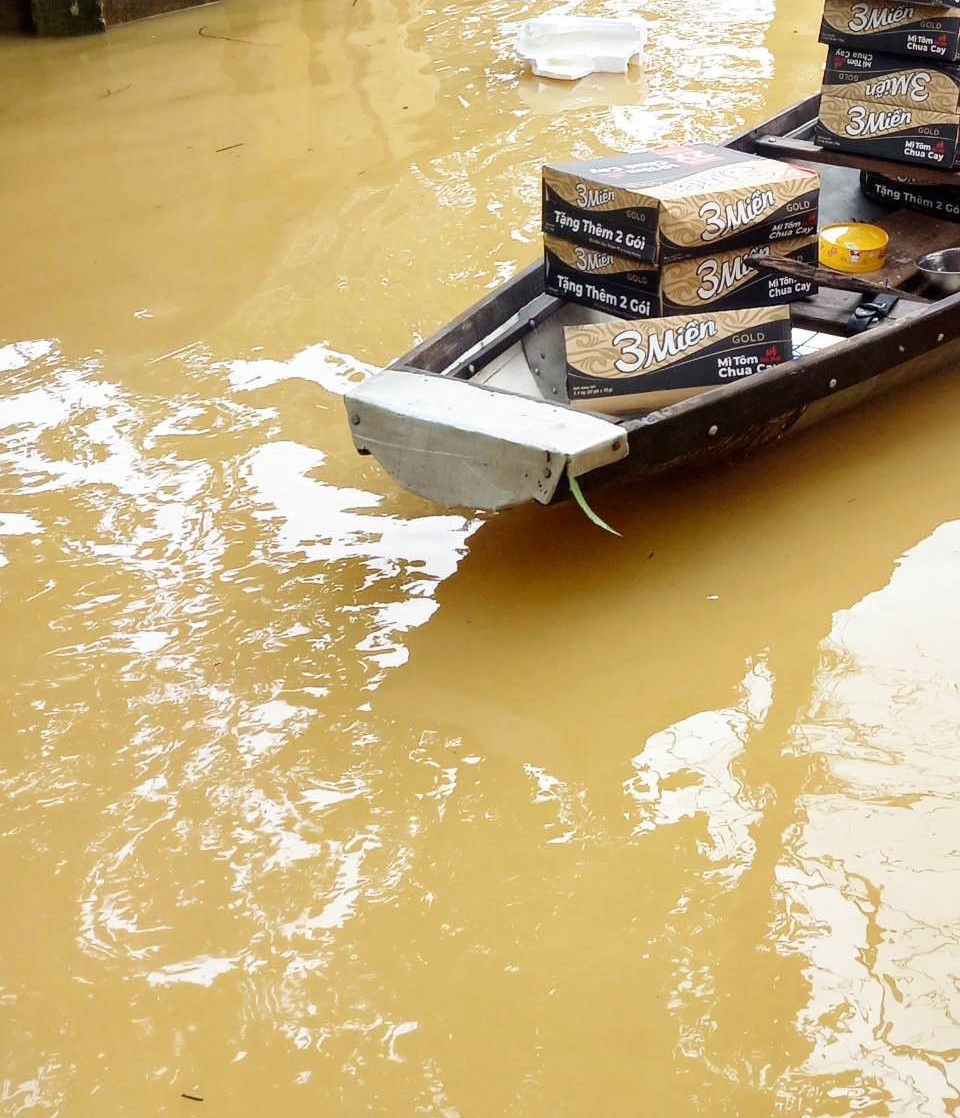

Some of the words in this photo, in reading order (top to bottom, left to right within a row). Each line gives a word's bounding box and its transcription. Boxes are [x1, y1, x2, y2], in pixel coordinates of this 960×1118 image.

[907, 34, 917, 43] Mì
[918, 36, 933, 44] Tôm
[835, 48, 850, 58] Cay
[906, 42, 928, 51] Chua
[930, 45, 947, 55] Cay
[852, 52, 873, 60] Chua
[838, 73, 859, 81] GOLD
[918, 128, 940, 136] GOLD
[905, 140, 915, 149] Mì
[915, 141, 931, 150] Tôm
[904, 148, 926, 158] Chua
[927, 150, 944, 162] Cay
[875, 184, 901, 200] Tặng
[904, 193, 934, 209] Thêm
[935, 200, 943, 210] 2
[786, 200, 810, 213] GOLD
[626, 210, 646, 222] GOLD
[554, 210, 580, 232] Tặng
[582, 219, 614, 240] Thêm
[615, 230, 623, 243] 2
[625, 234, 646, 251] Gói
[772, 223, 783, 232] Mì
[784, 221, 801, 231] Tôm
[769, 228, 794, 240] Chua
[795, 226, 814, 237] Cay
[626, 273, 648, 285] GOLD
[768, 279, 779, 288] Mì
[557, 275, 583, 297] Tặng
[585, 284, 617, 306] Thêm
[620, 295, 627, 309] 2
[630, 299, 651, 316] Gói
[768, 286, 792, 298] Chua
[795, 282, 812, 293] Cay
[732, 332, 765, 344] GOLD
[718, 357, 732, 368] Mì
[733, 355, 758, 366] Tôm
[719, 366, 752, 379] Chua
